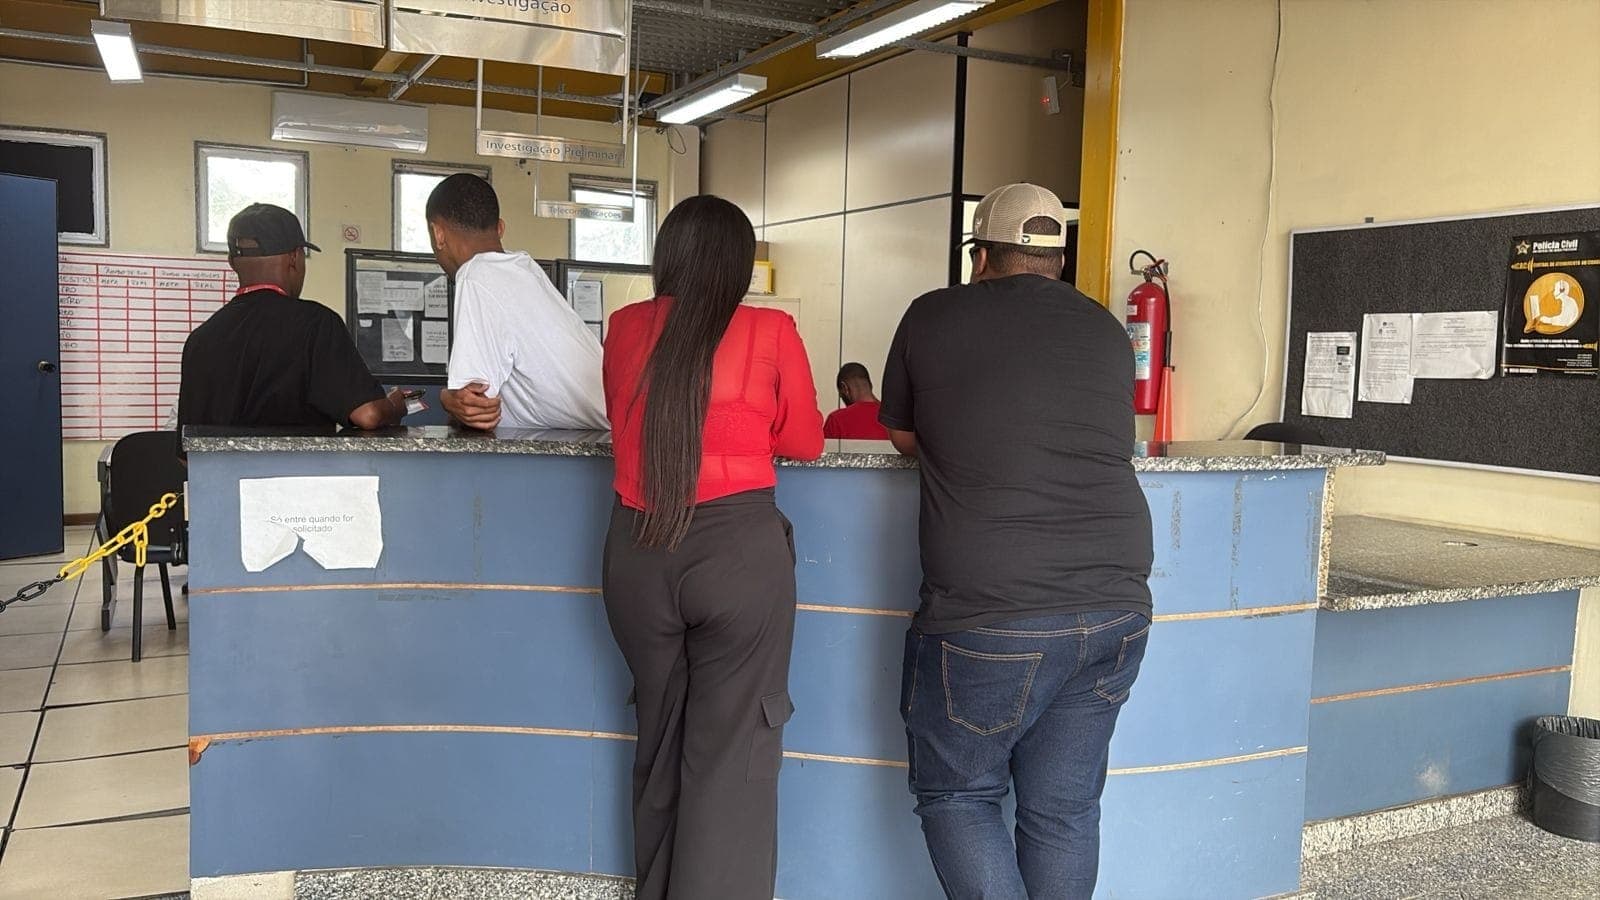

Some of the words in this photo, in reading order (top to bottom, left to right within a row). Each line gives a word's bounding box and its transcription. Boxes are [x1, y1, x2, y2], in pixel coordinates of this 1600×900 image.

[463, 0, 571, 14] stigação
[486, 140, 560, 155] Investigação
[564, 144, 618, 160] Preliminar
[308, 515, 341, 525] quando
[342, 514, 354, 522] for
[293, 525, 333, 533] solicitado
